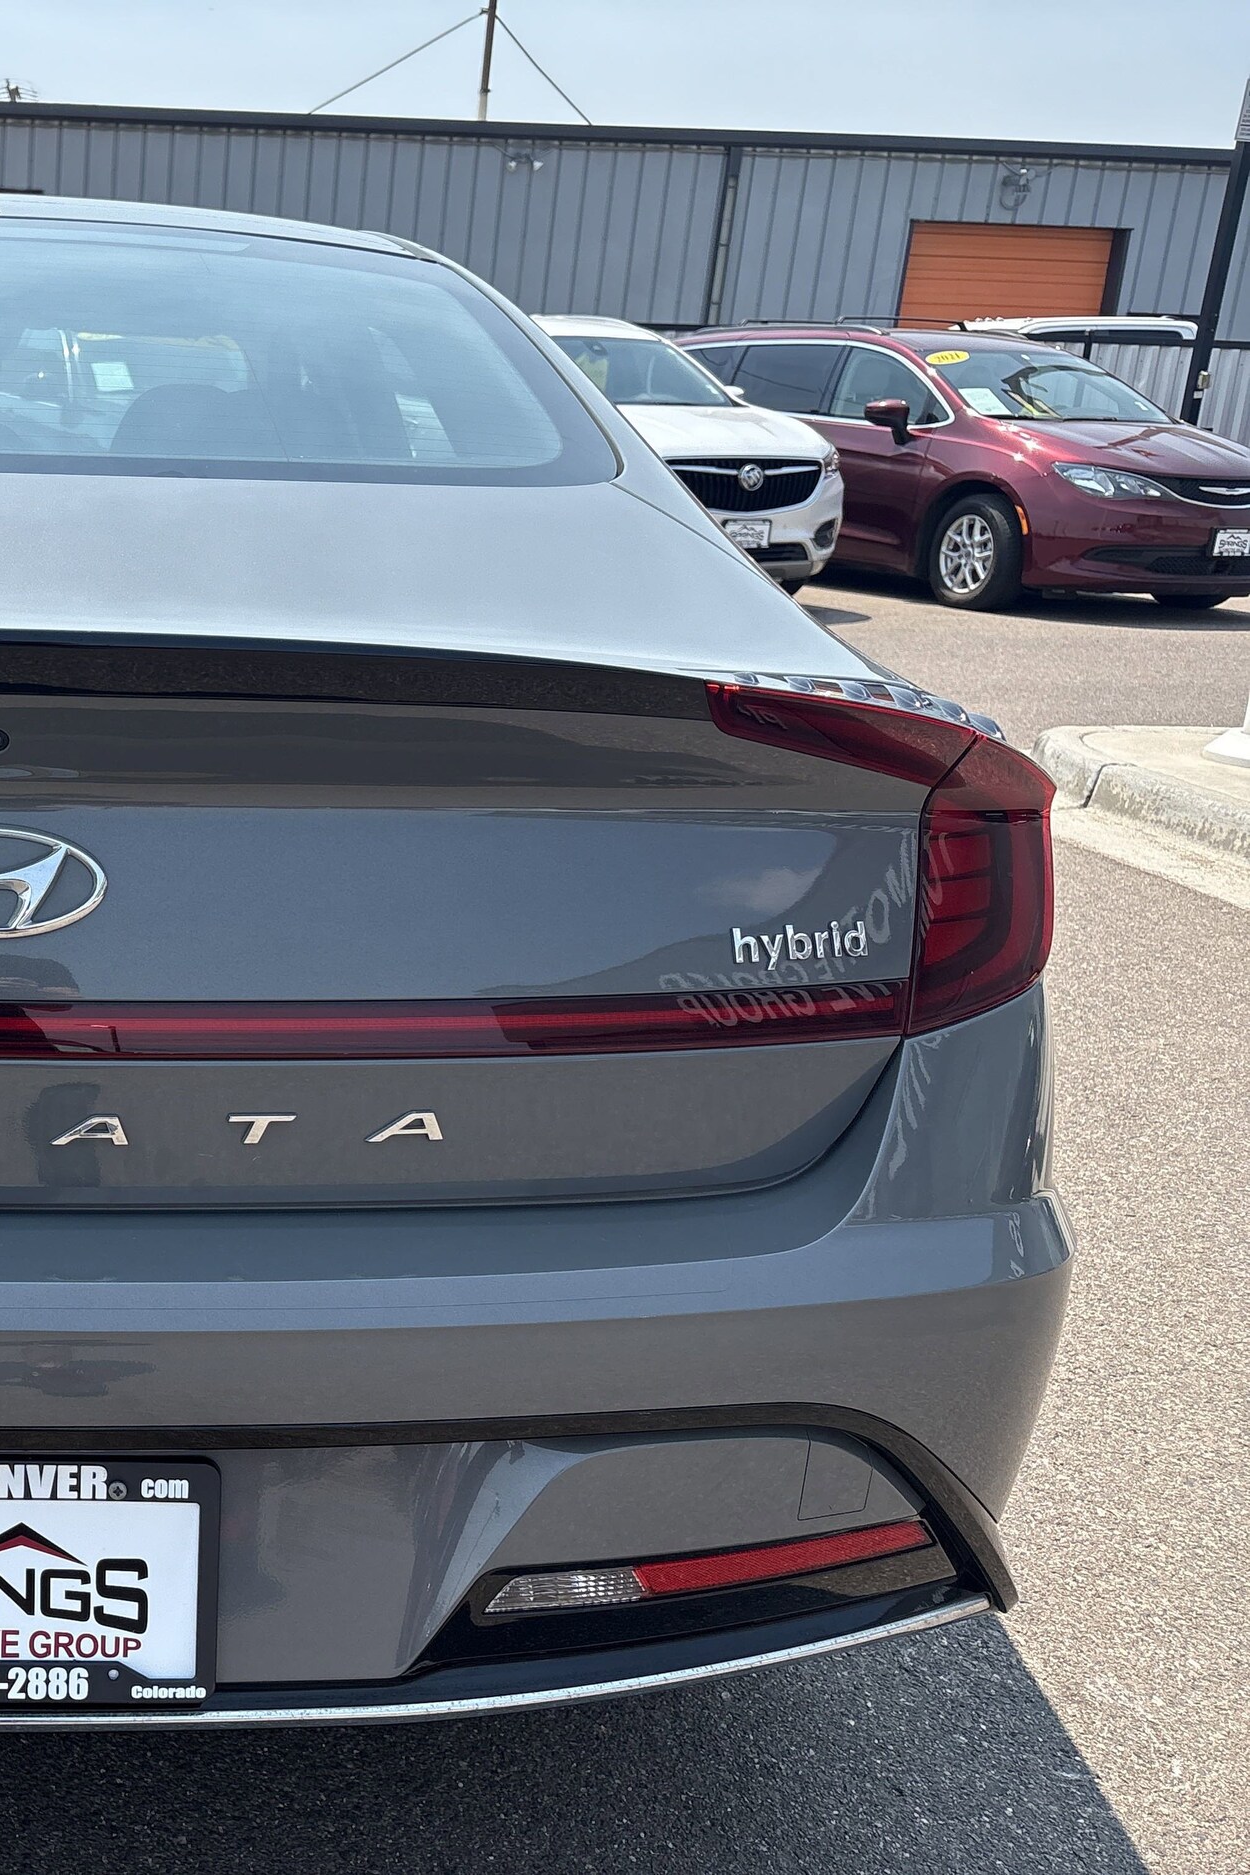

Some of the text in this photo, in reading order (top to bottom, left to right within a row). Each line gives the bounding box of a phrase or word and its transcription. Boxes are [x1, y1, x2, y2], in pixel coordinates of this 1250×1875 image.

[732, 921, 868, 970] hybrid
[140, 1478, 189, 1499] com
[28, 1630, 142, 1659] GROUP
[130, 1685, 207, 1699] Colorado
